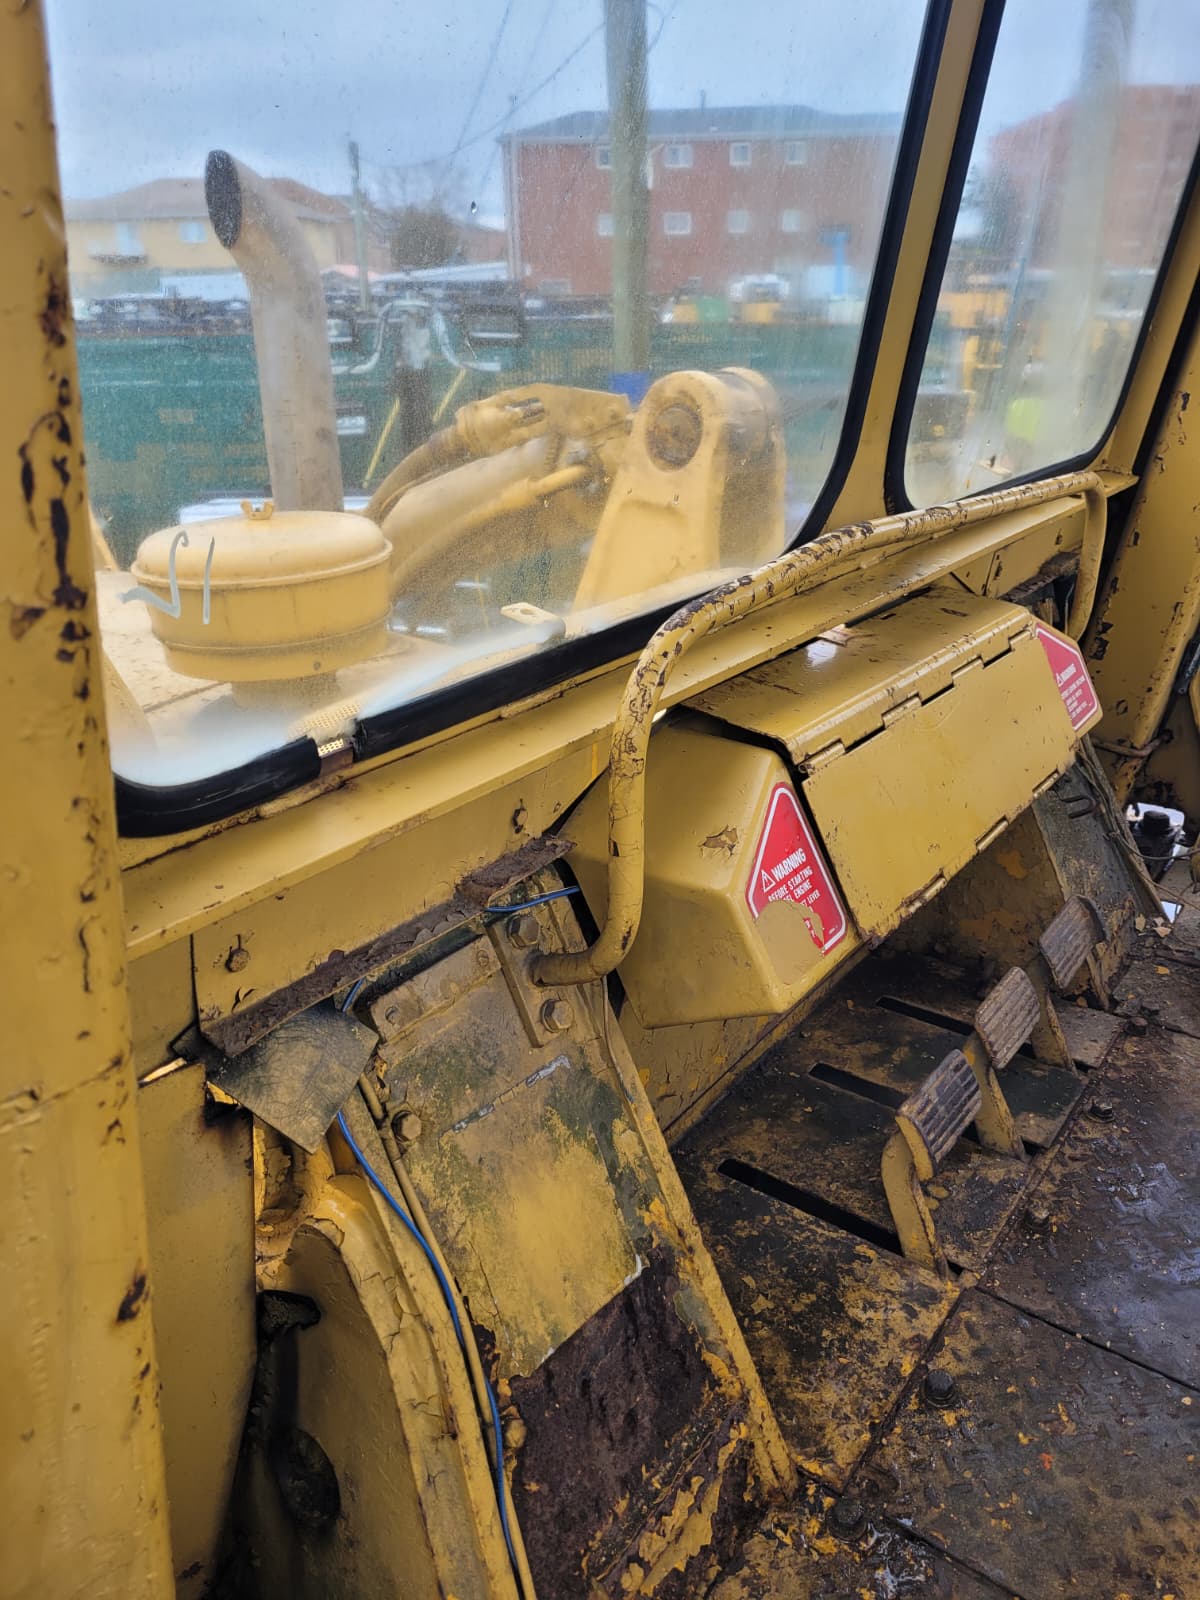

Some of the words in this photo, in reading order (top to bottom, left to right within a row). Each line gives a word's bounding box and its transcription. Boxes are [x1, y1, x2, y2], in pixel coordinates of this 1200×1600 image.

[771, 848, 807, 881] WARNING
[787, 866, 813, 890] STARTING
[793, 879, 812, 899] ENGINE
